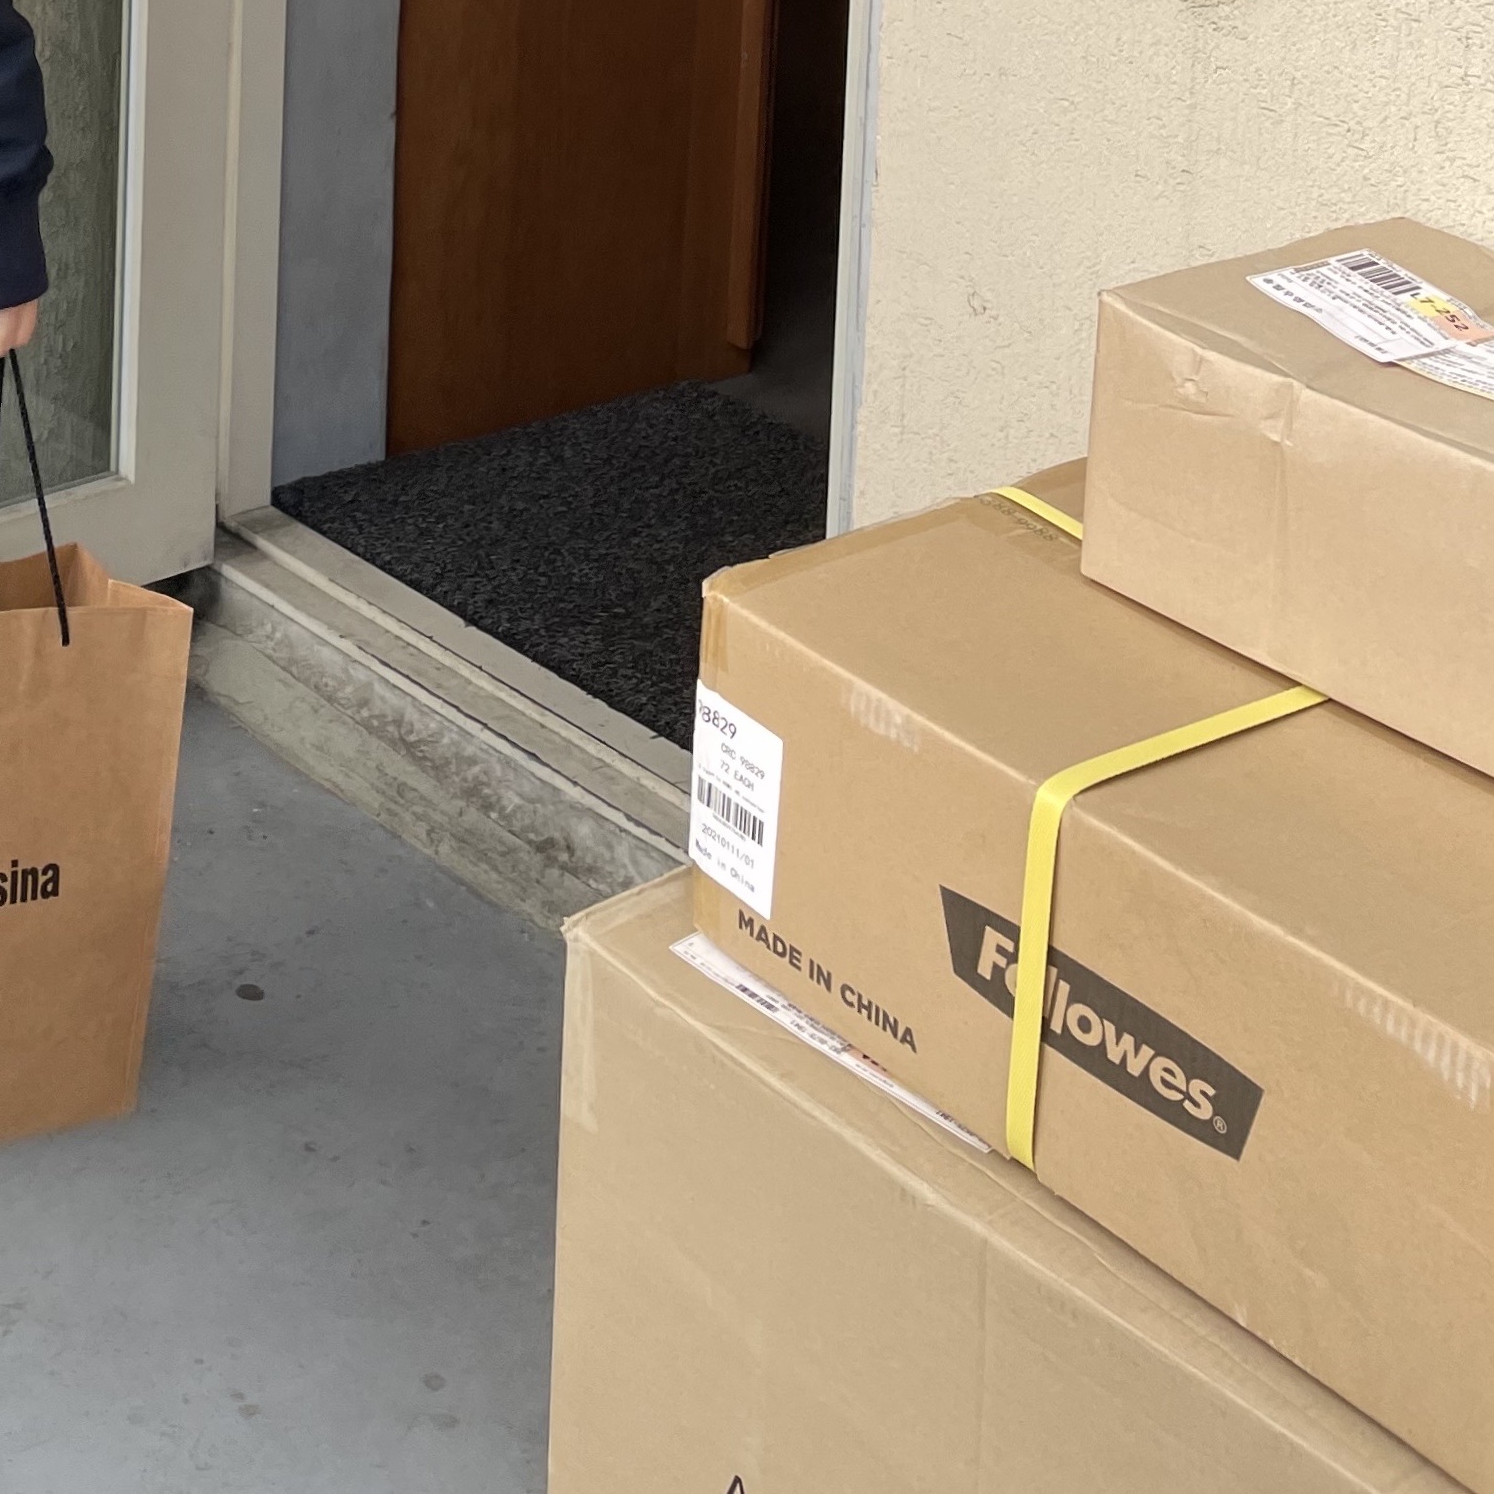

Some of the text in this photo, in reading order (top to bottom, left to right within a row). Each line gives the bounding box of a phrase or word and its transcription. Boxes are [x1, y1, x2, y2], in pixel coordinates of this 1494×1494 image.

[738, 908, 803, 972] MADE
[809, 958, 832, 993] IN
[840, 983, 917, 1054] CHINA
